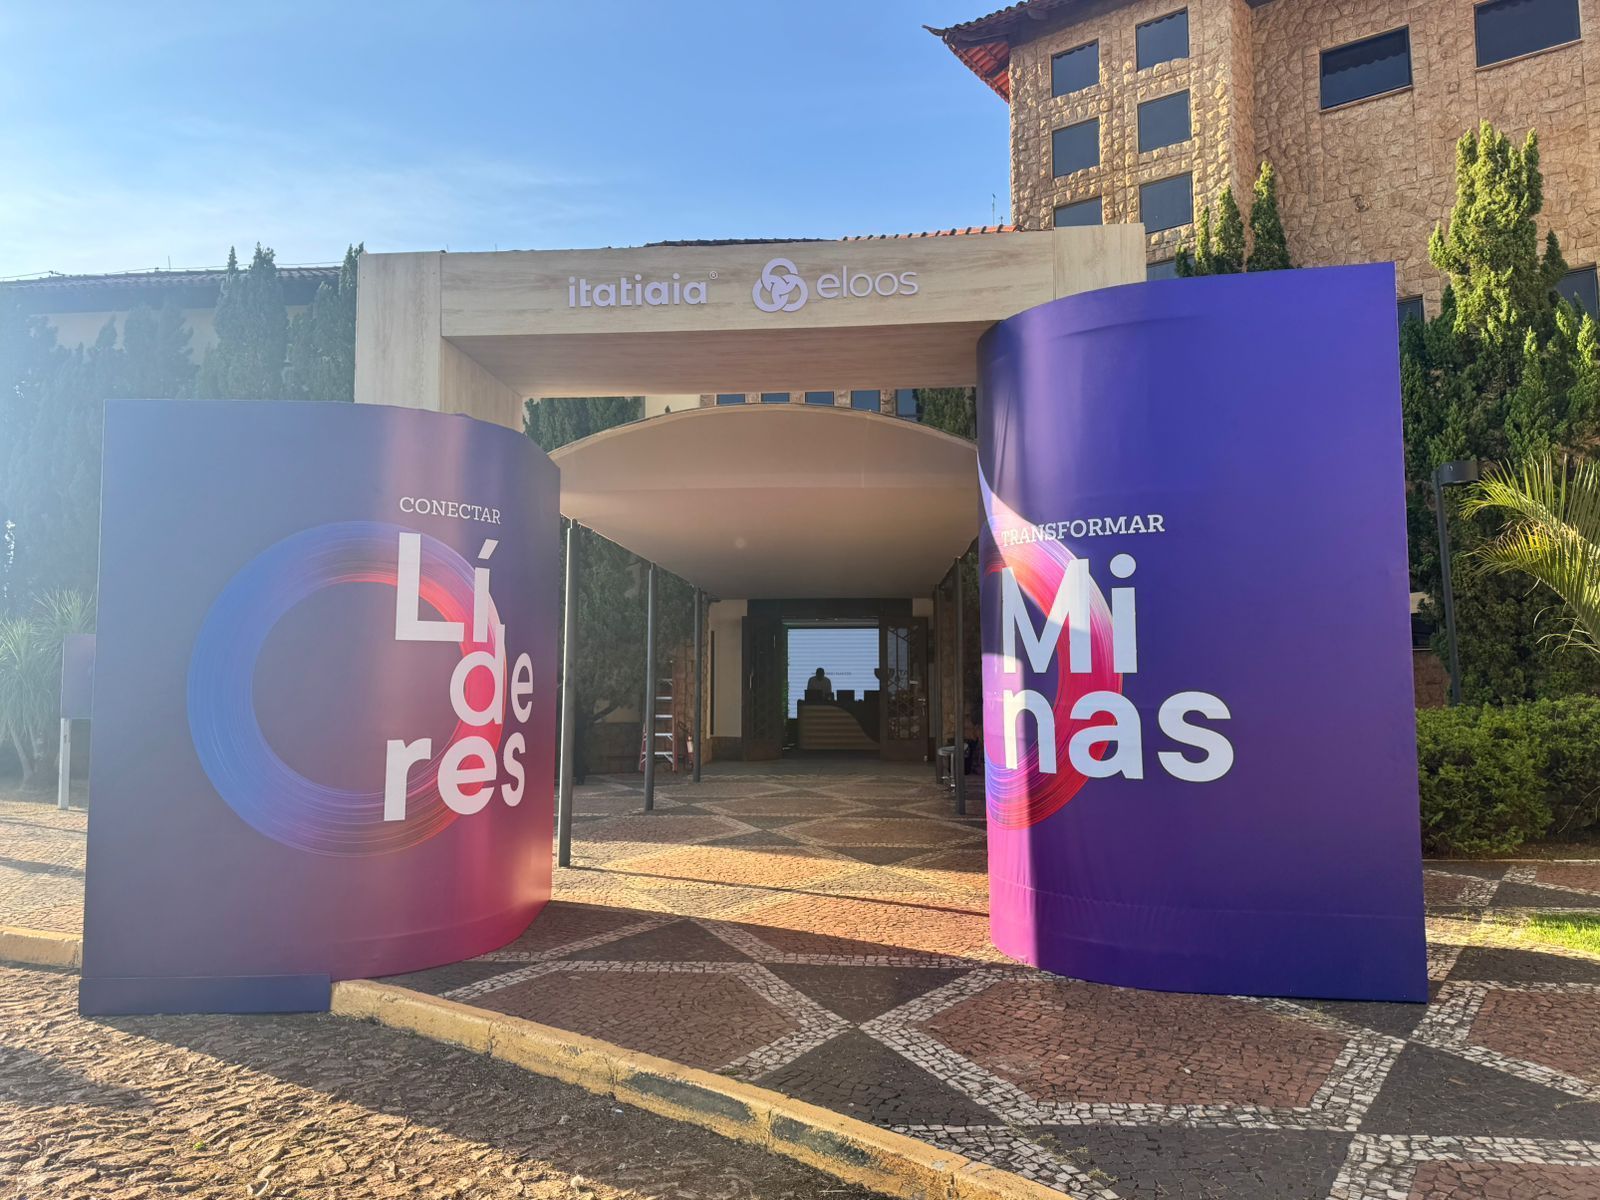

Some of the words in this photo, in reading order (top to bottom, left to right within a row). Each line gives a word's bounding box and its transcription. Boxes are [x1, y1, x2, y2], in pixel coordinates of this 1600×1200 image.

[816, 265, 919, 299] eloos
[400, 496, 501, 525] CONECTAR
[1001, 514, 1166, 547] TRANSFORMAR
[395, 531, 499, 643] Lí
[1001, 553, 1138, 674] Mi
[449, 623, 534, 727] de
[383, 731, 526, 822] res
[1003, 689, 1235, 783] nas
